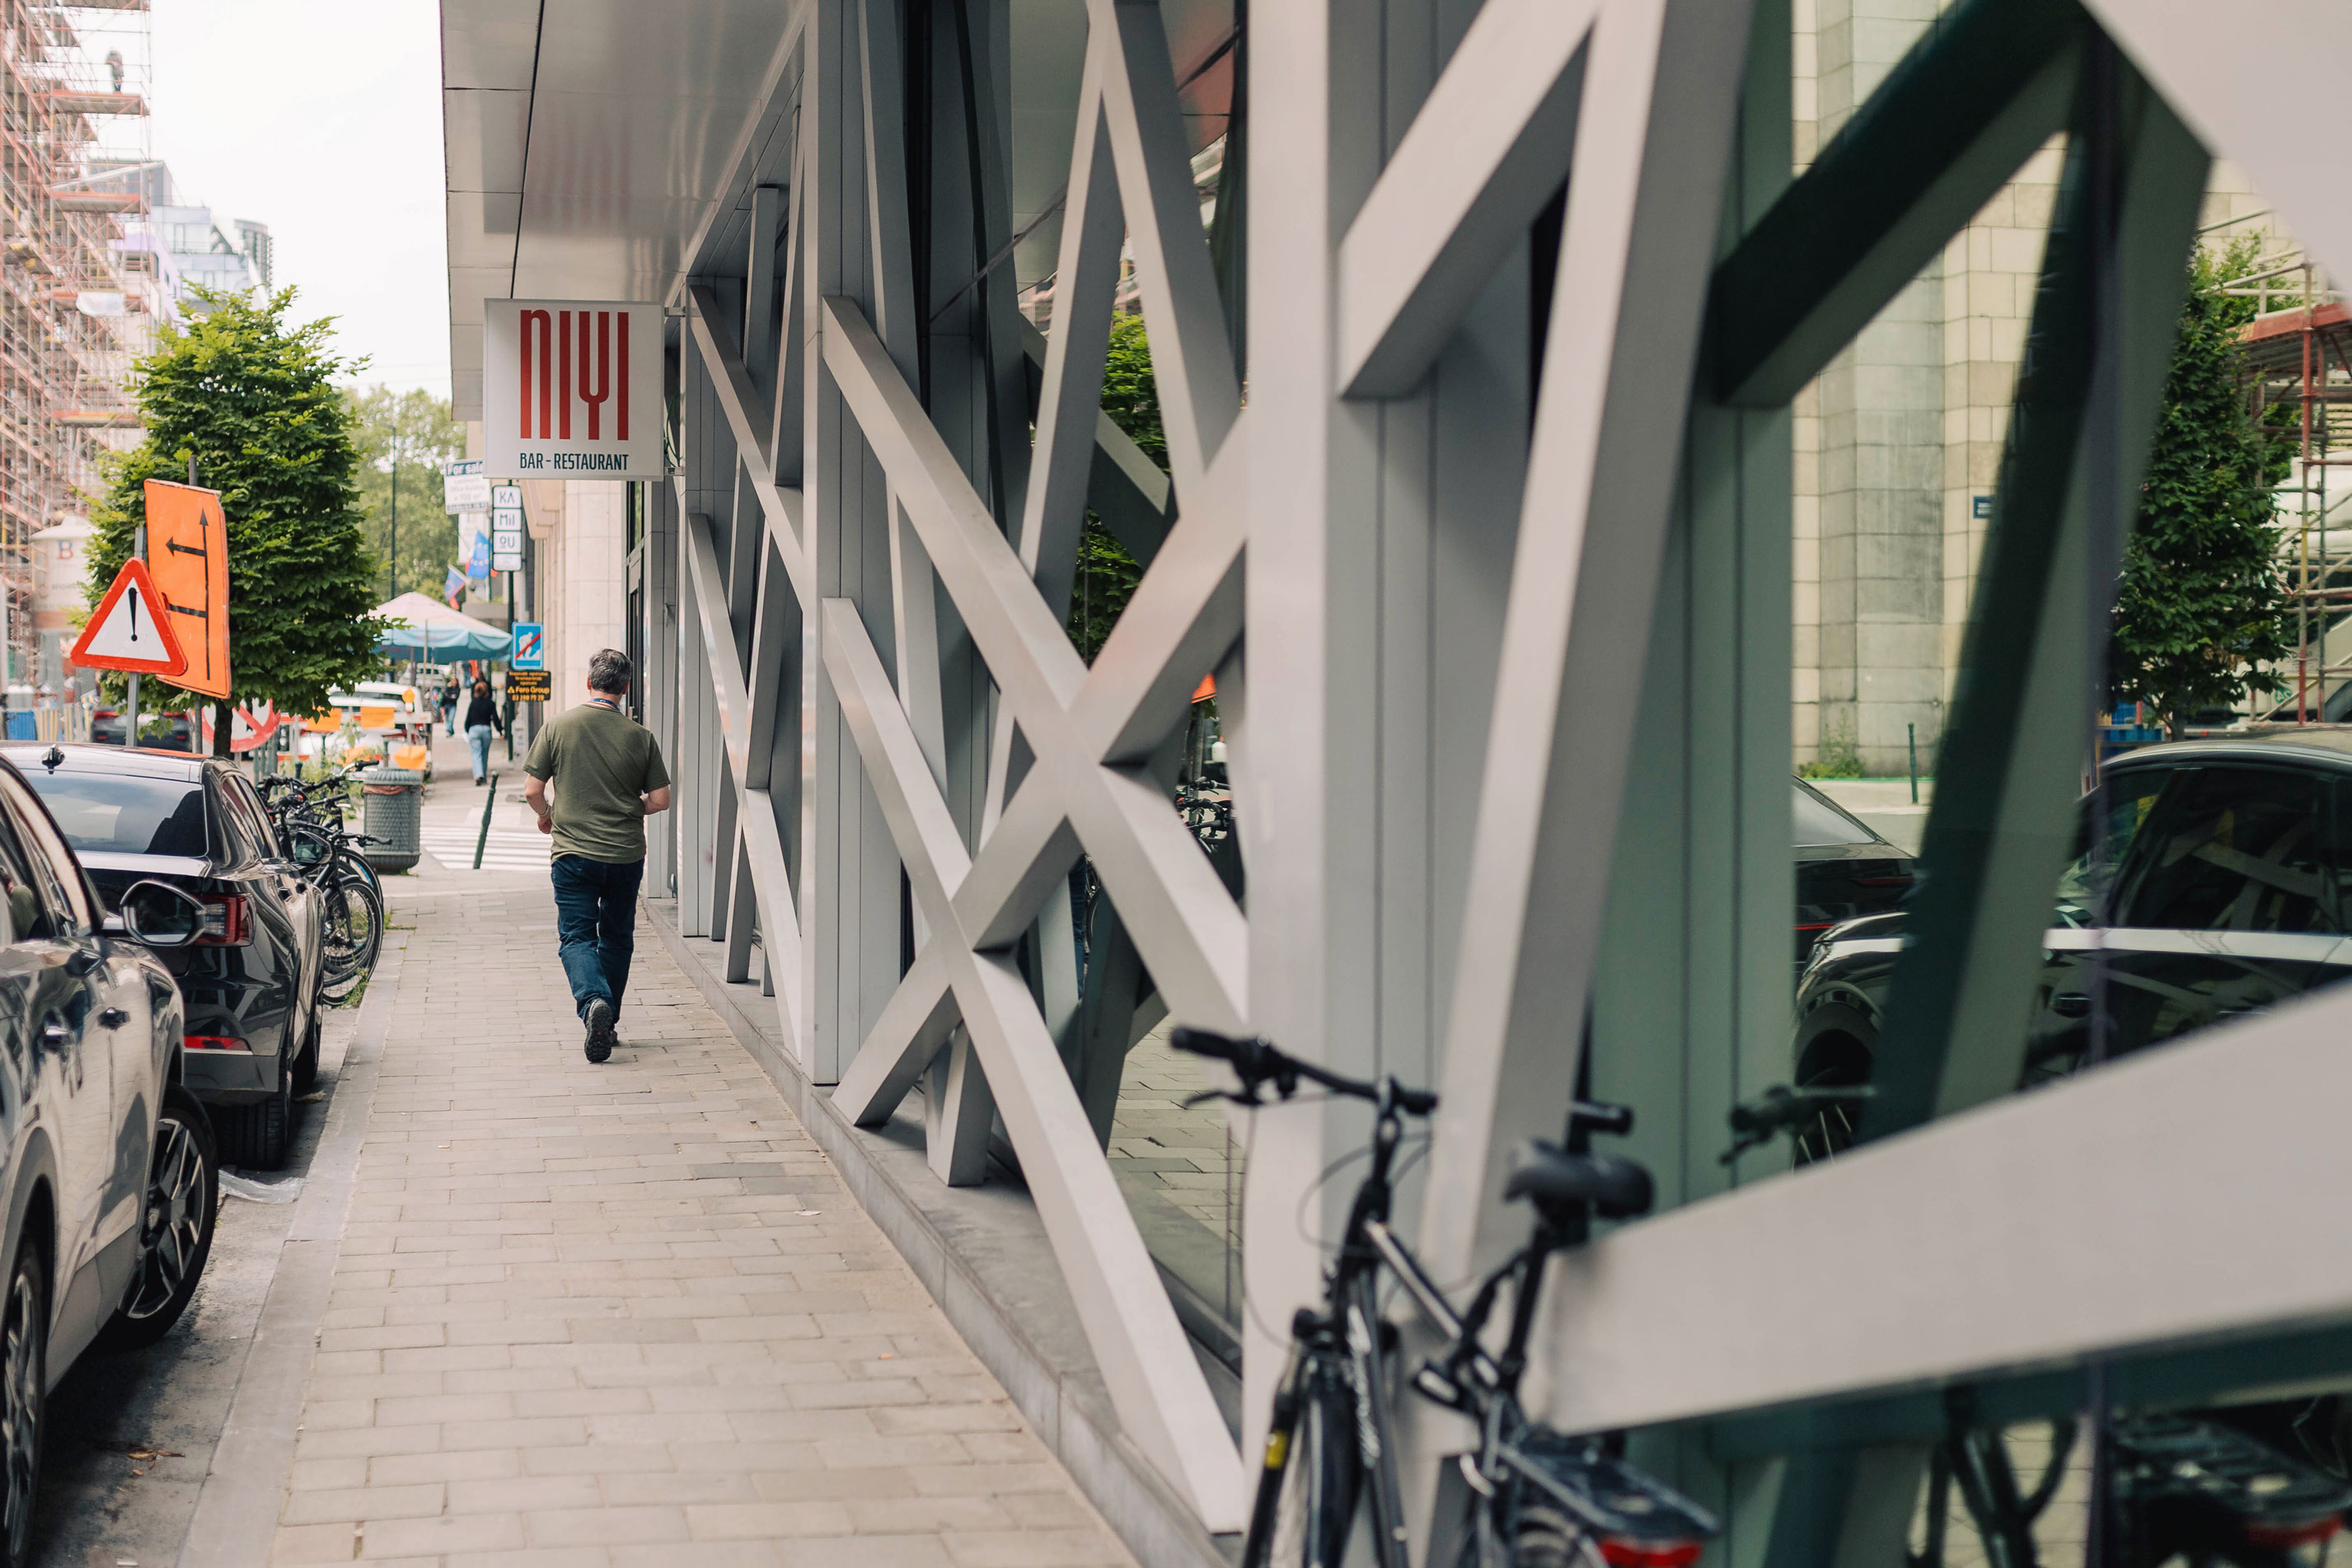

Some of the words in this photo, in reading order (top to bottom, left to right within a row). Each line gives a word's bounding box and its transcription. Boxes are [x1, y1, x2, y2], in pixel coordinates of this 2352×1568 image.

[447, 462, 464, 475] For
[520, 452, 543, 469] BAR
[554, 453, 629, 470] RESTAURANT
